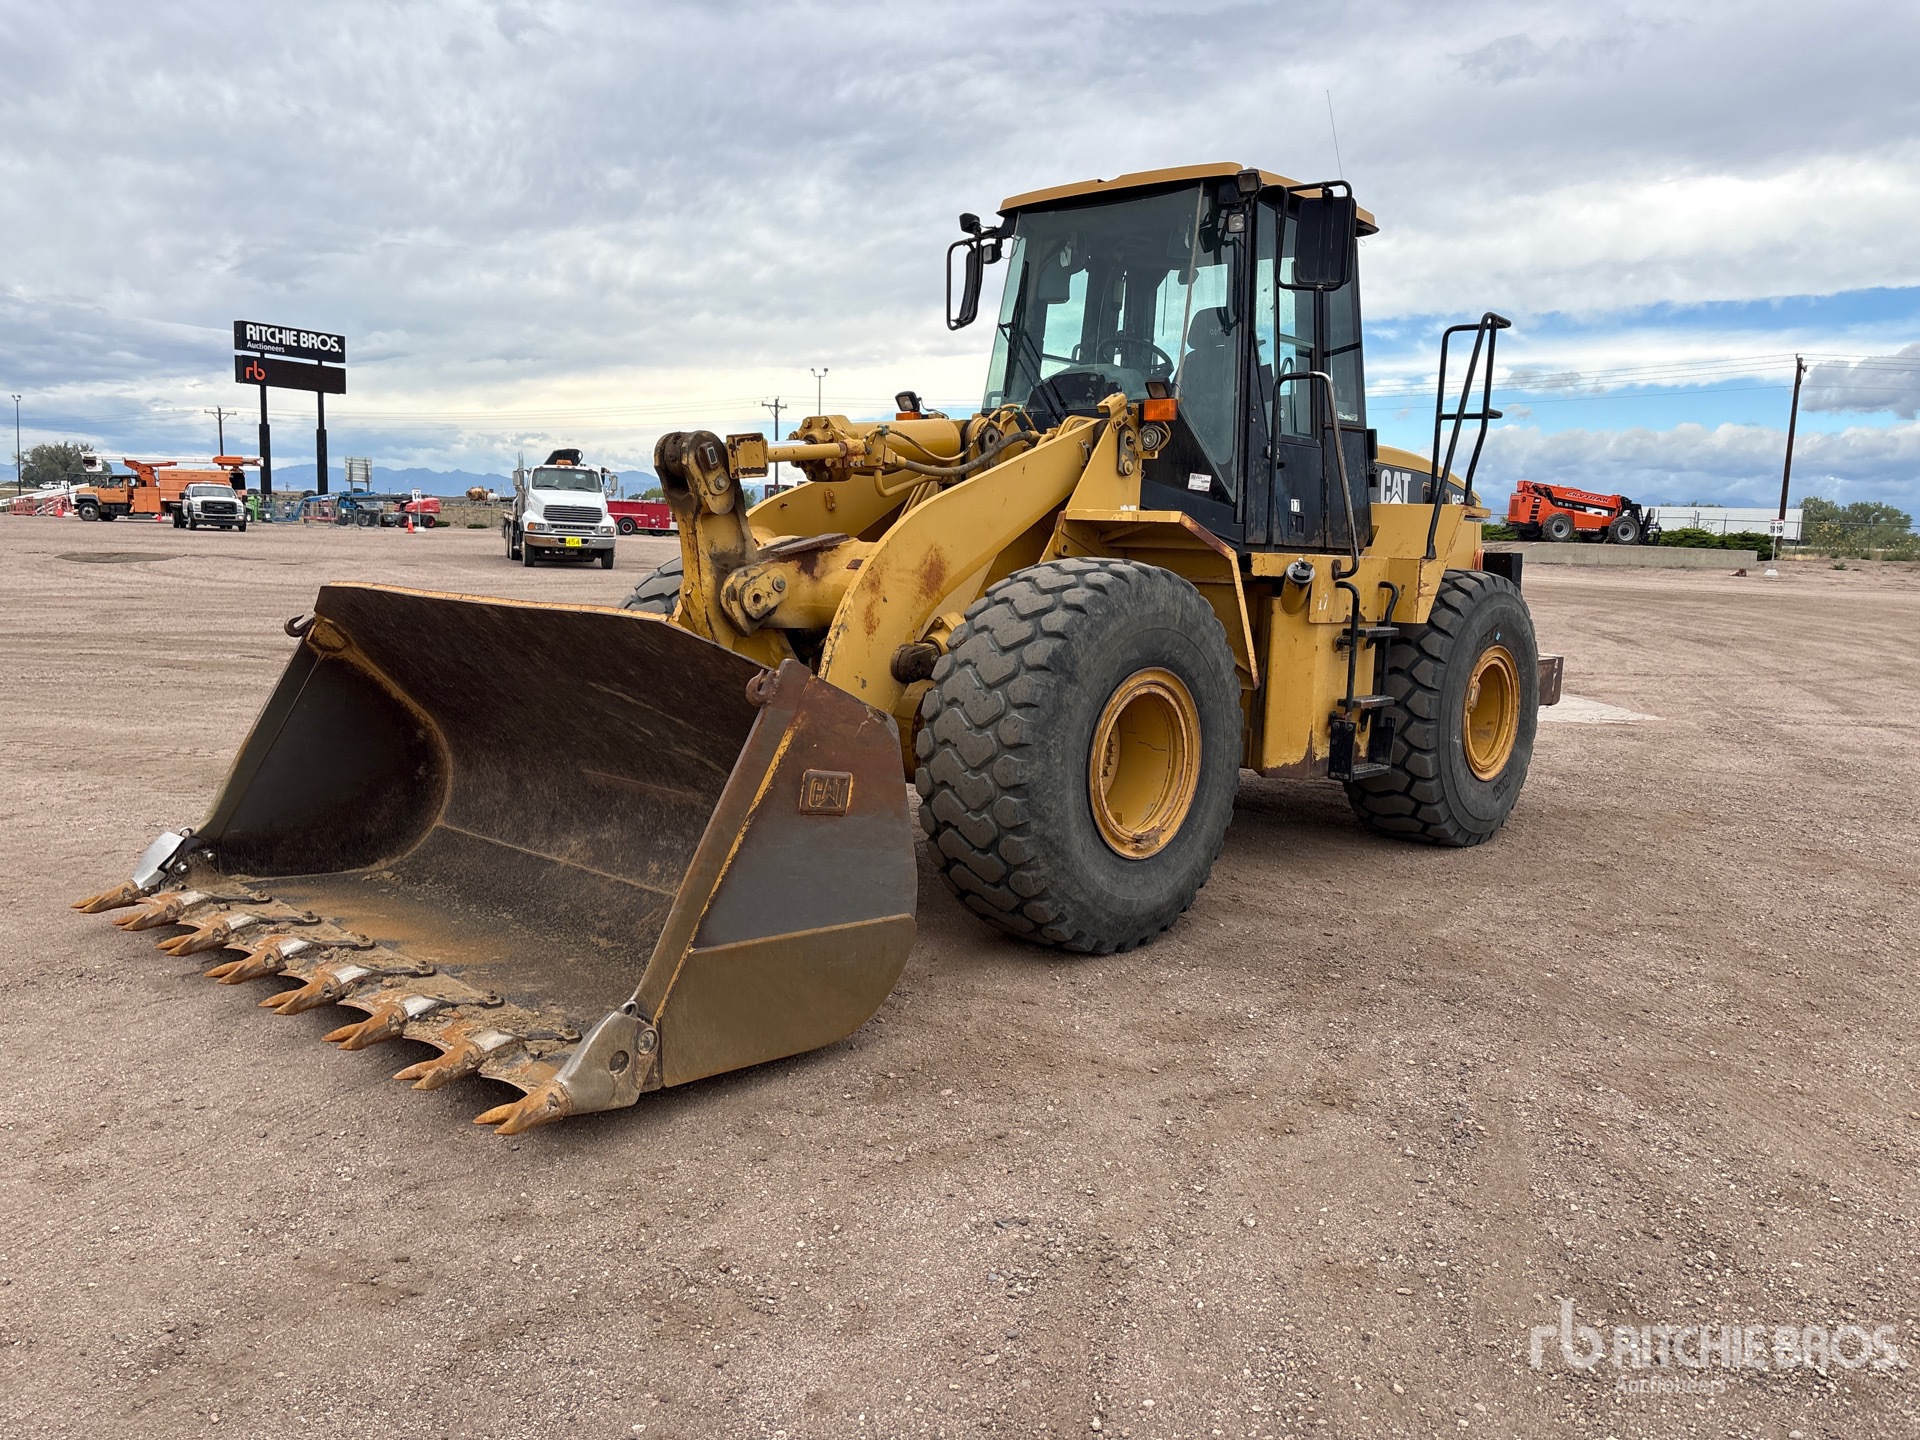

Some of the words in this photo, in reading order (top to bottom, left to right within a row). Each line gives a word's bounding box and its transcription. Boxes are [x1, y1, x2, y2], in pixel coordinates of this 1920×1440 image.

[246, 324, 298, 347] RITCHIE
[300, 332, 342, 353] BROS.
[247, 341, 285, 353] Auctioneers
[1380, 469, 1412, 504] CAT
[1565, 491, 1611, 504] SKYTRAK
[808, 777, 848, 808] CAT
